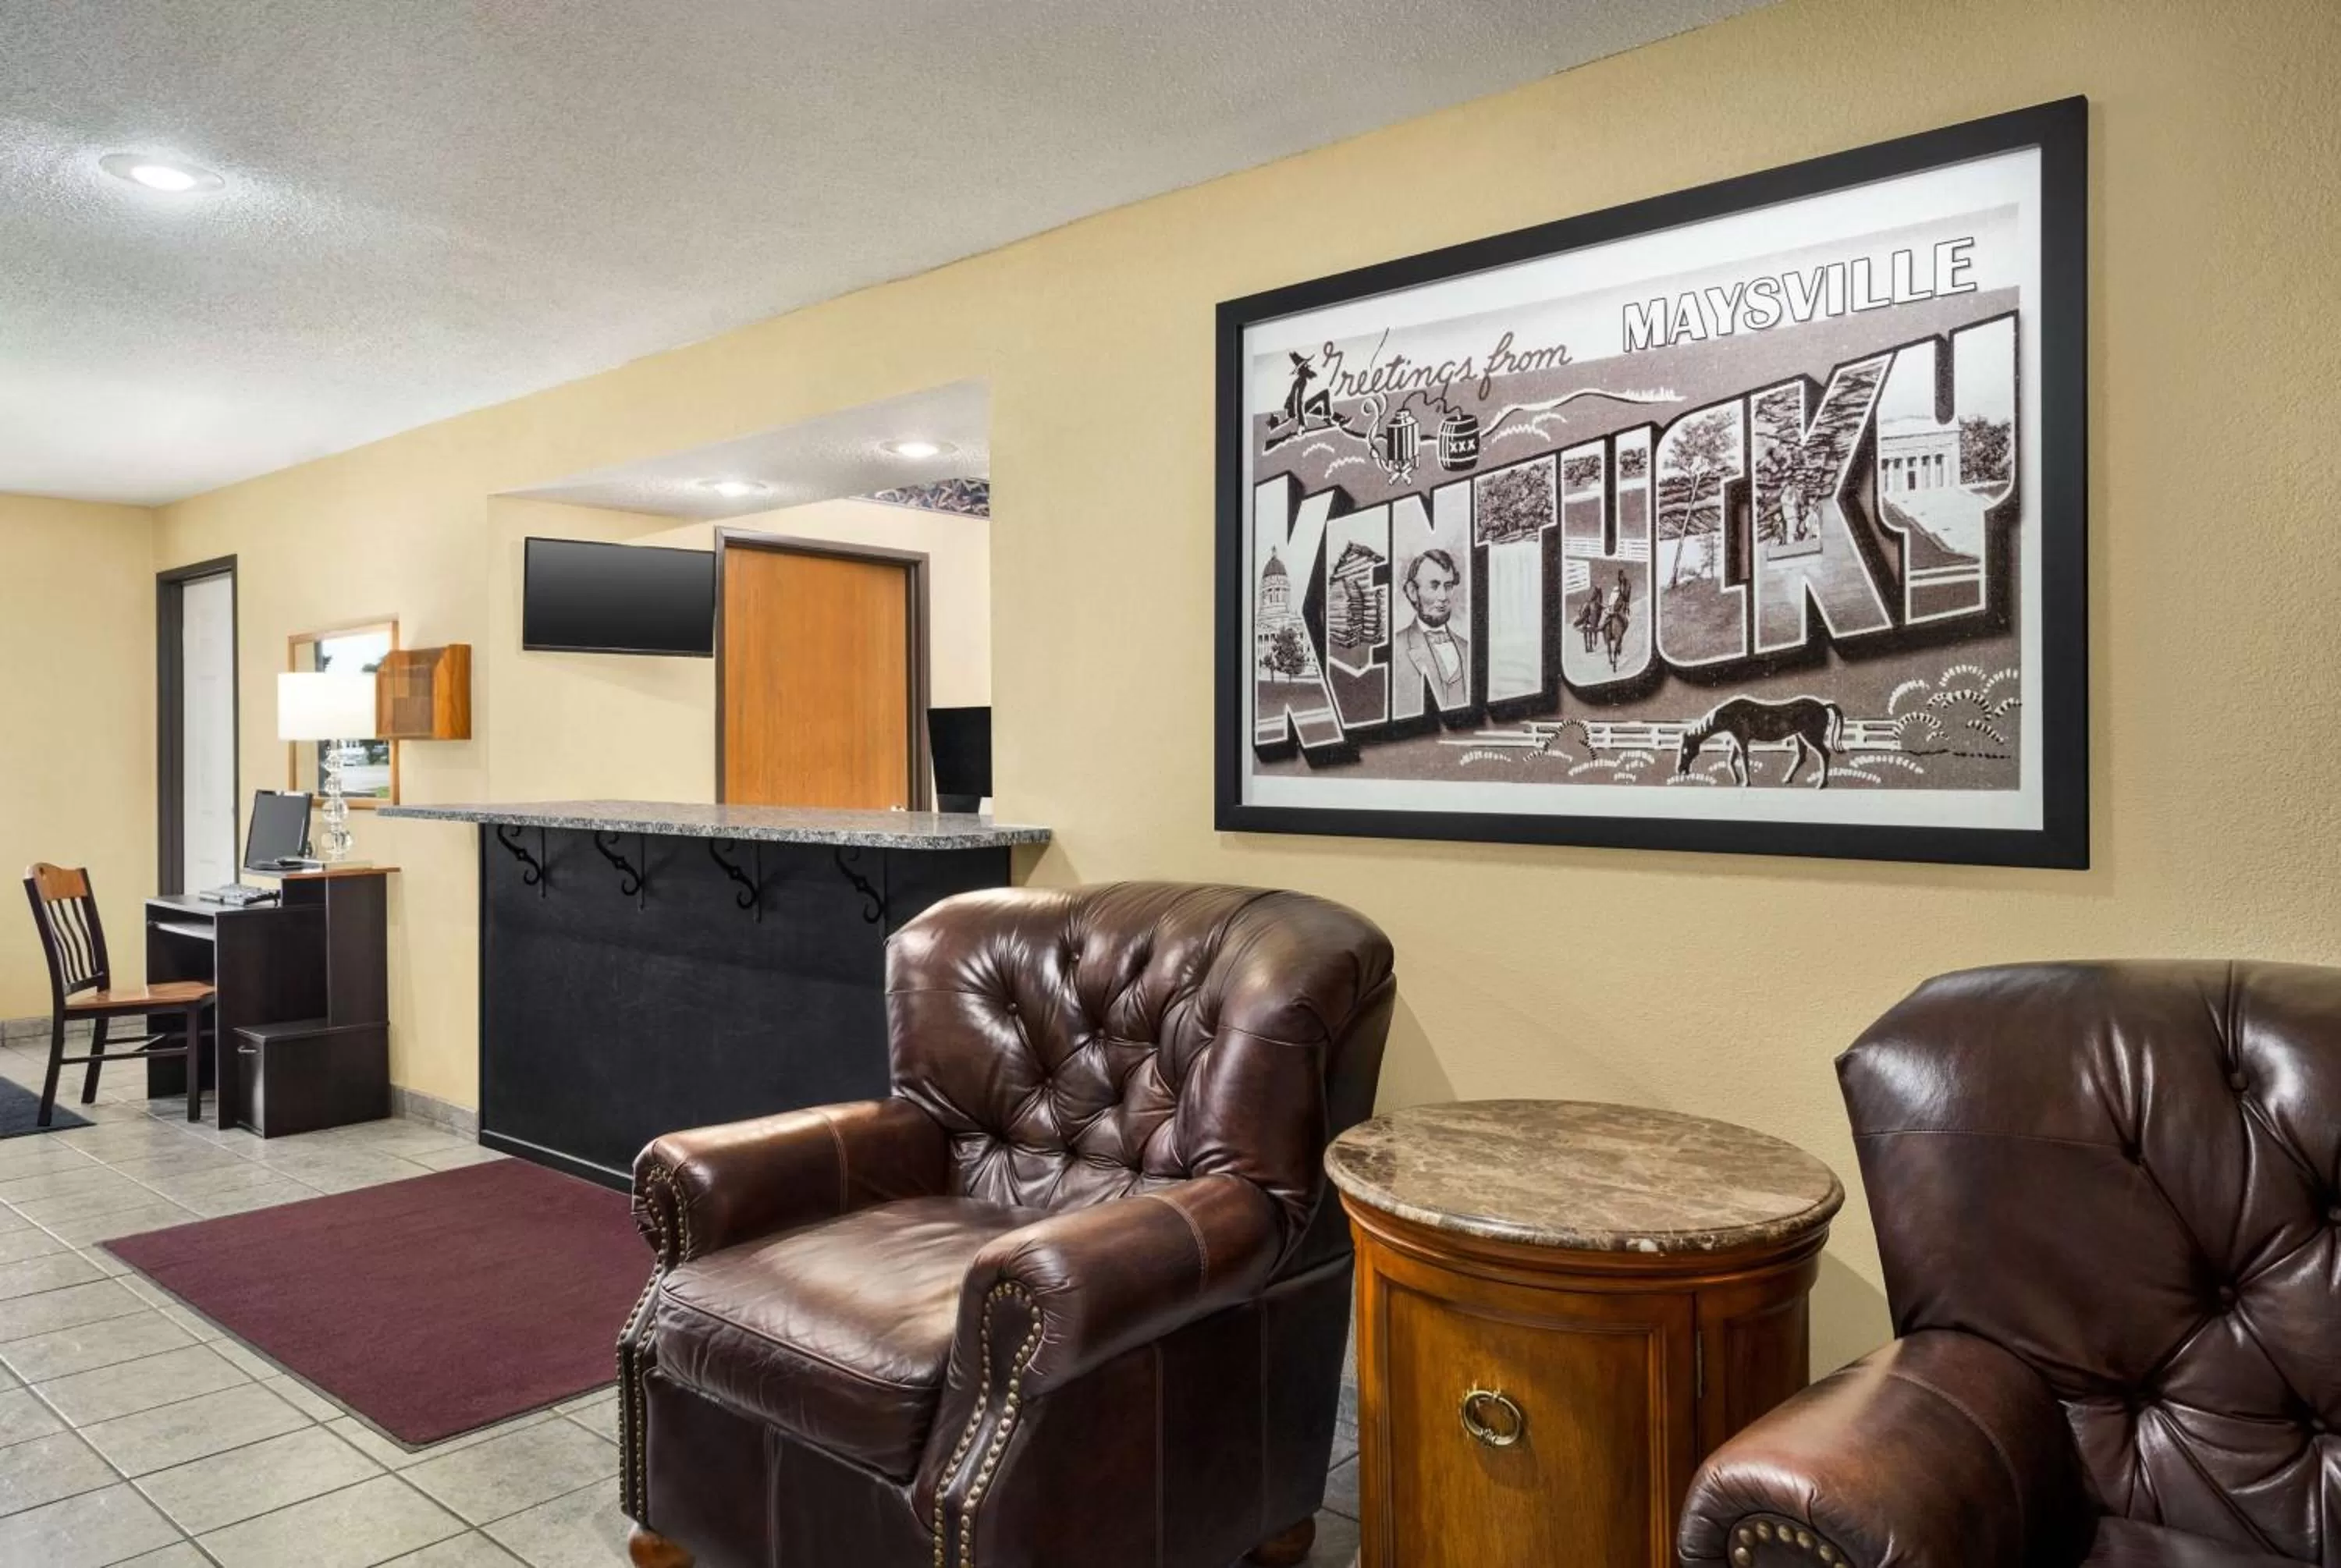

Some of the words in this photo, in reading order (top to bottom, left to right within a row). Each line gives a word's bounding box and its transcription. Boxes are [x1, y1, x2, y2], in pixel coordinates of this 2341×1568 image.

[1622, 236, 1978, 353] MAYSVILLE
[1323, 340, 1478, 413] Greetings
[1480, 331, 1573, 401] from
[1448, 438, 1477, 454] XXX
[1252, 312, 2020, 750] KENTUCKY
